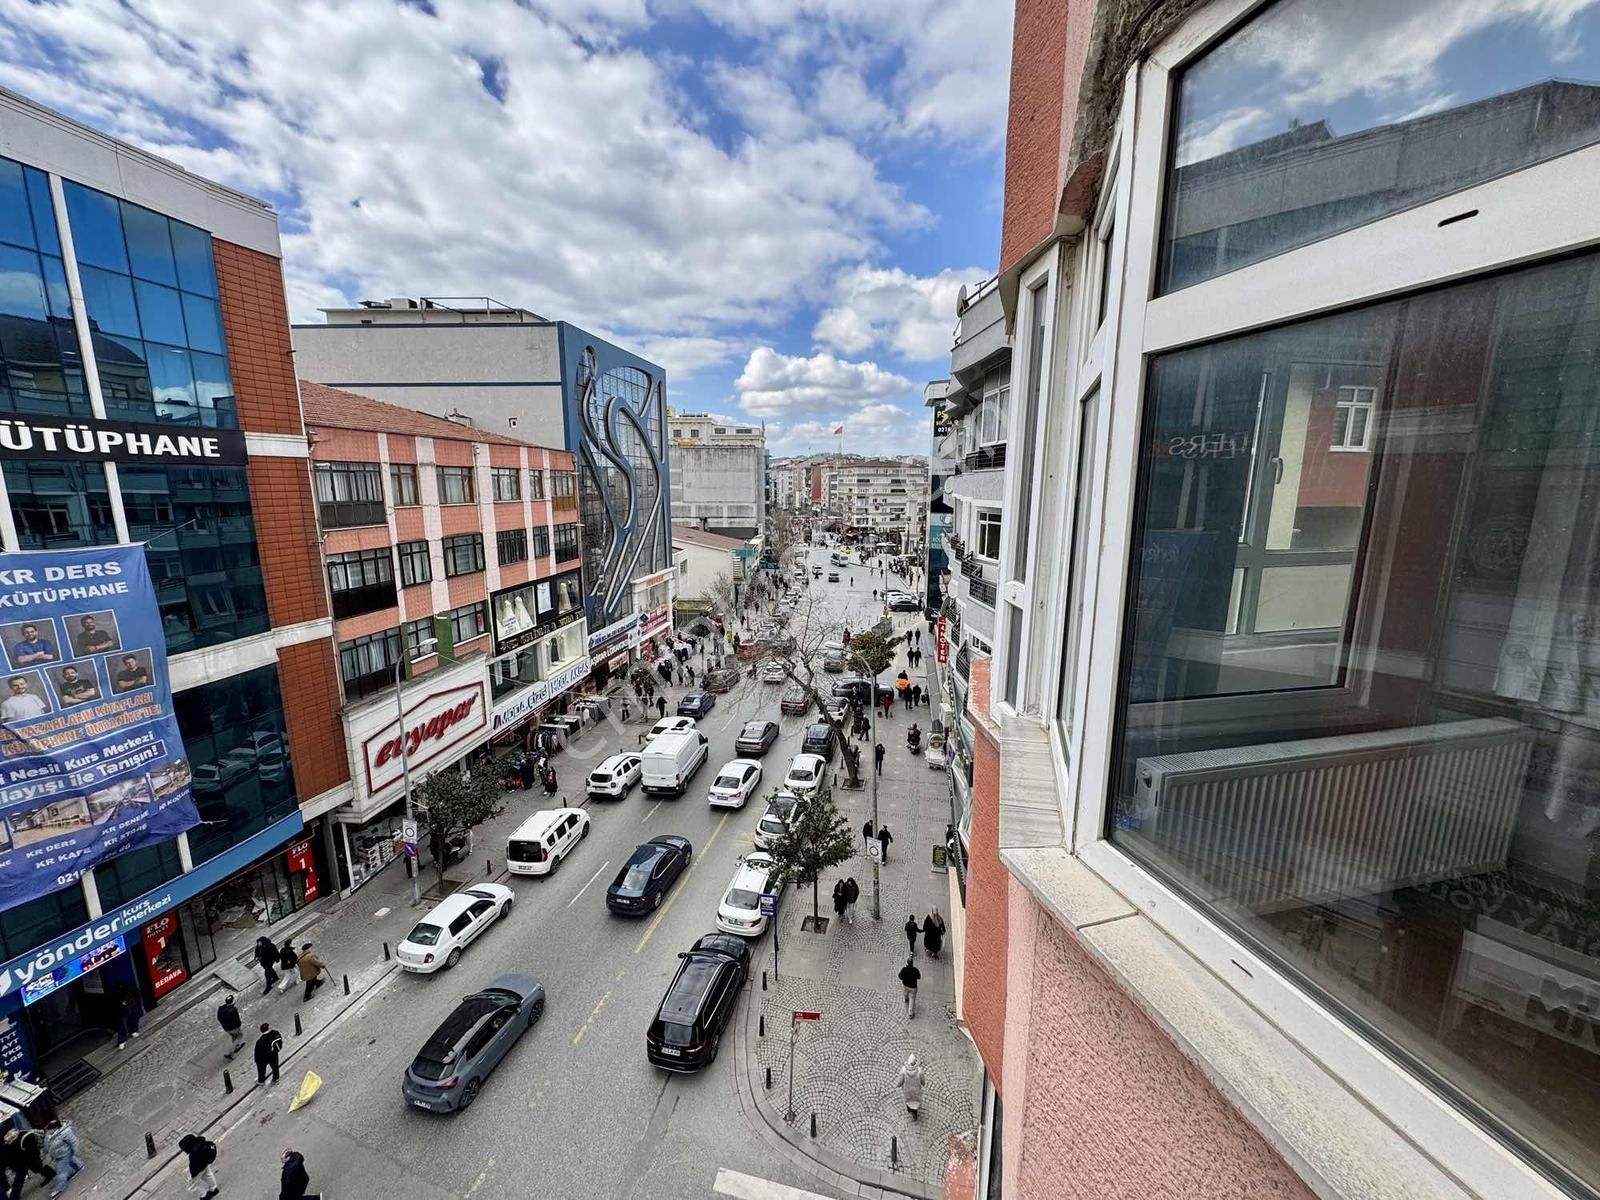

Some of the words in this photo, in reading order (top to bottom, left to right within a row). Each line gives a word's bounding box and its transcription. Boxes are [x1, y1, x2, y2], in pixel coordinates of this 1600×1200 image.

[44, 561, 122, 582] DERS
[0, 582, 129, 608] KÜTÜPHANE
[10, 762, 60, 782] Nesil
[64, 753, 100, 772] Kurs
[103, 731, 154, 758] Merkezi
[69, 773, 95, 788] ile
[96, 745, 158, 778] Tanışın!
[26, 847, 43, 859] KR
[46, 838, 76, 853] DERS
[35, 858, 55, 870] KR
[123, 899, 150, 918] kurs
[123, 894, 172, 927] merkezi
[146, 917, 169, 934] FLO
[14, 917, 121, 985] yönder
[157, 936, 166, 949] 1
[154, 968, 183, 989] BEDAVA
[4, 1051, 24, 1066] LGS
